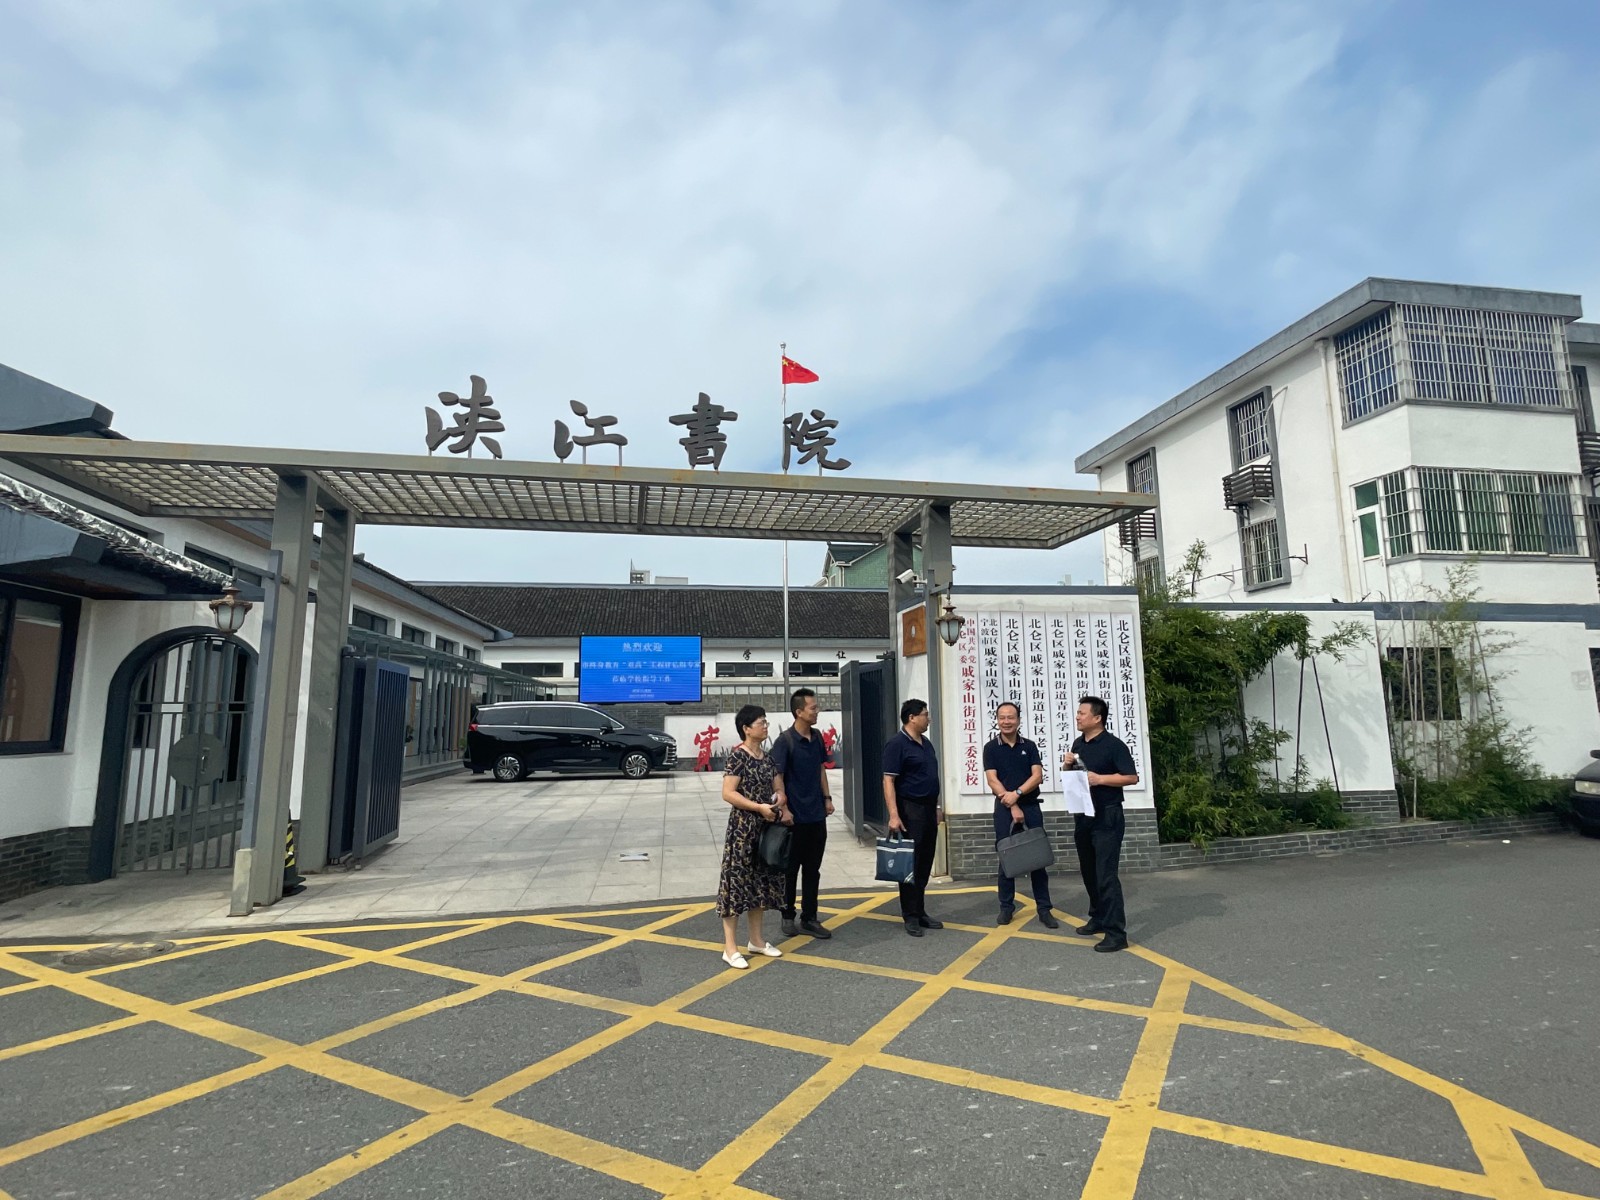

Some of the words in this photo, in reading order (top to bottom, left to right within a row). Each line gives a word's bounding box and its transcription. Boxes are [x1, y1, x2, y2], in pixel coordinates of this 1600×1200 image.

[622, 642, 663, 652] 热烈欢迎
[1005, 618, 1024, 737] 北仑区戚家山街
[1050, 618, 1070, 783] 北仑区戚家山街道青年学习培
[1116, 619, 1140, 775] 北仑区戚家山街道社会工
[961, 665, 979, 786] 戚家山街道工委党校
